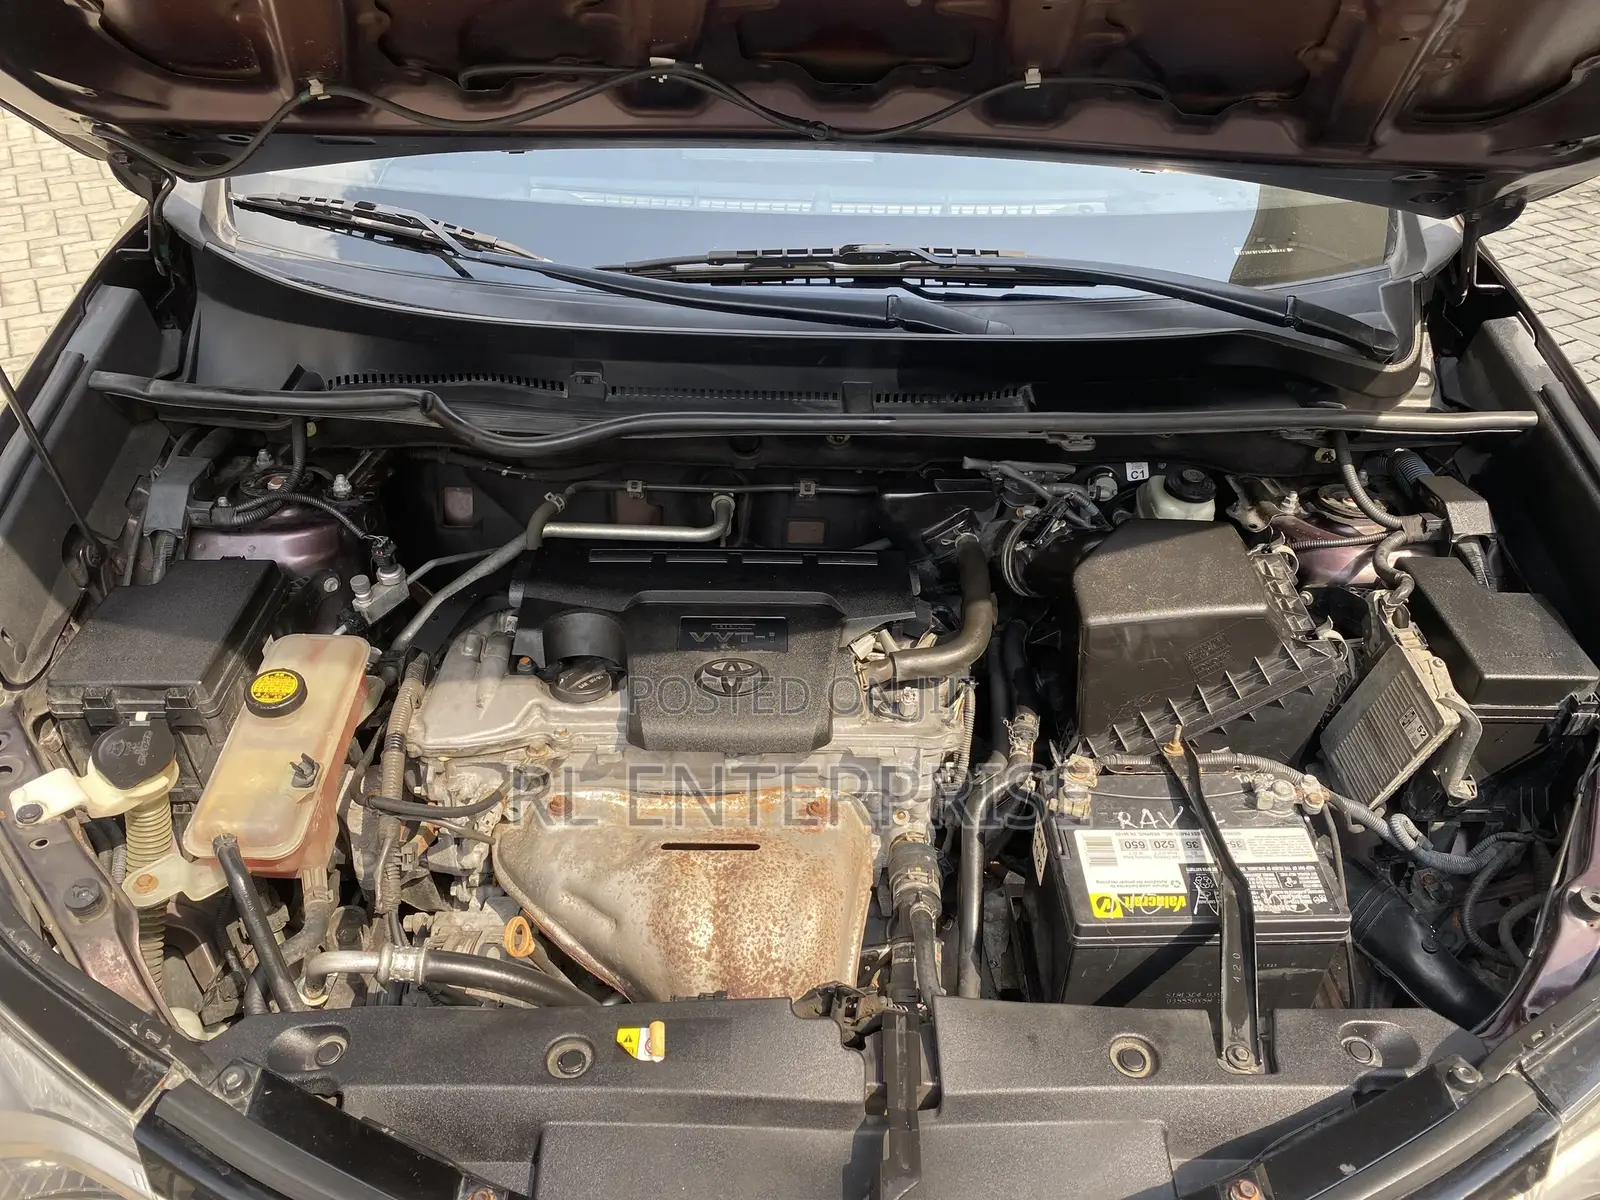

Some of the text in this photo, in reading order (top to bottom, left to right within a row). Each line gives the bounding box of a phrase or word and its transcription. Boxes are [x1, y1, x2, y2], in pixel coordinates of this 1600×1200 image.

[1130, 469, 1145, 480] C1
[689, 631, 776, 643] VVT-i
[1416, 725, 1427, 740] 52
[1117, 805, 1184, 830] RAV
[1124, 840, 1145, 849] 650
[1153, 840, 1175, 849] 520
[1186, 841, 1199, 849] 35
[1122, 894, 1187, 913] Valucraft
